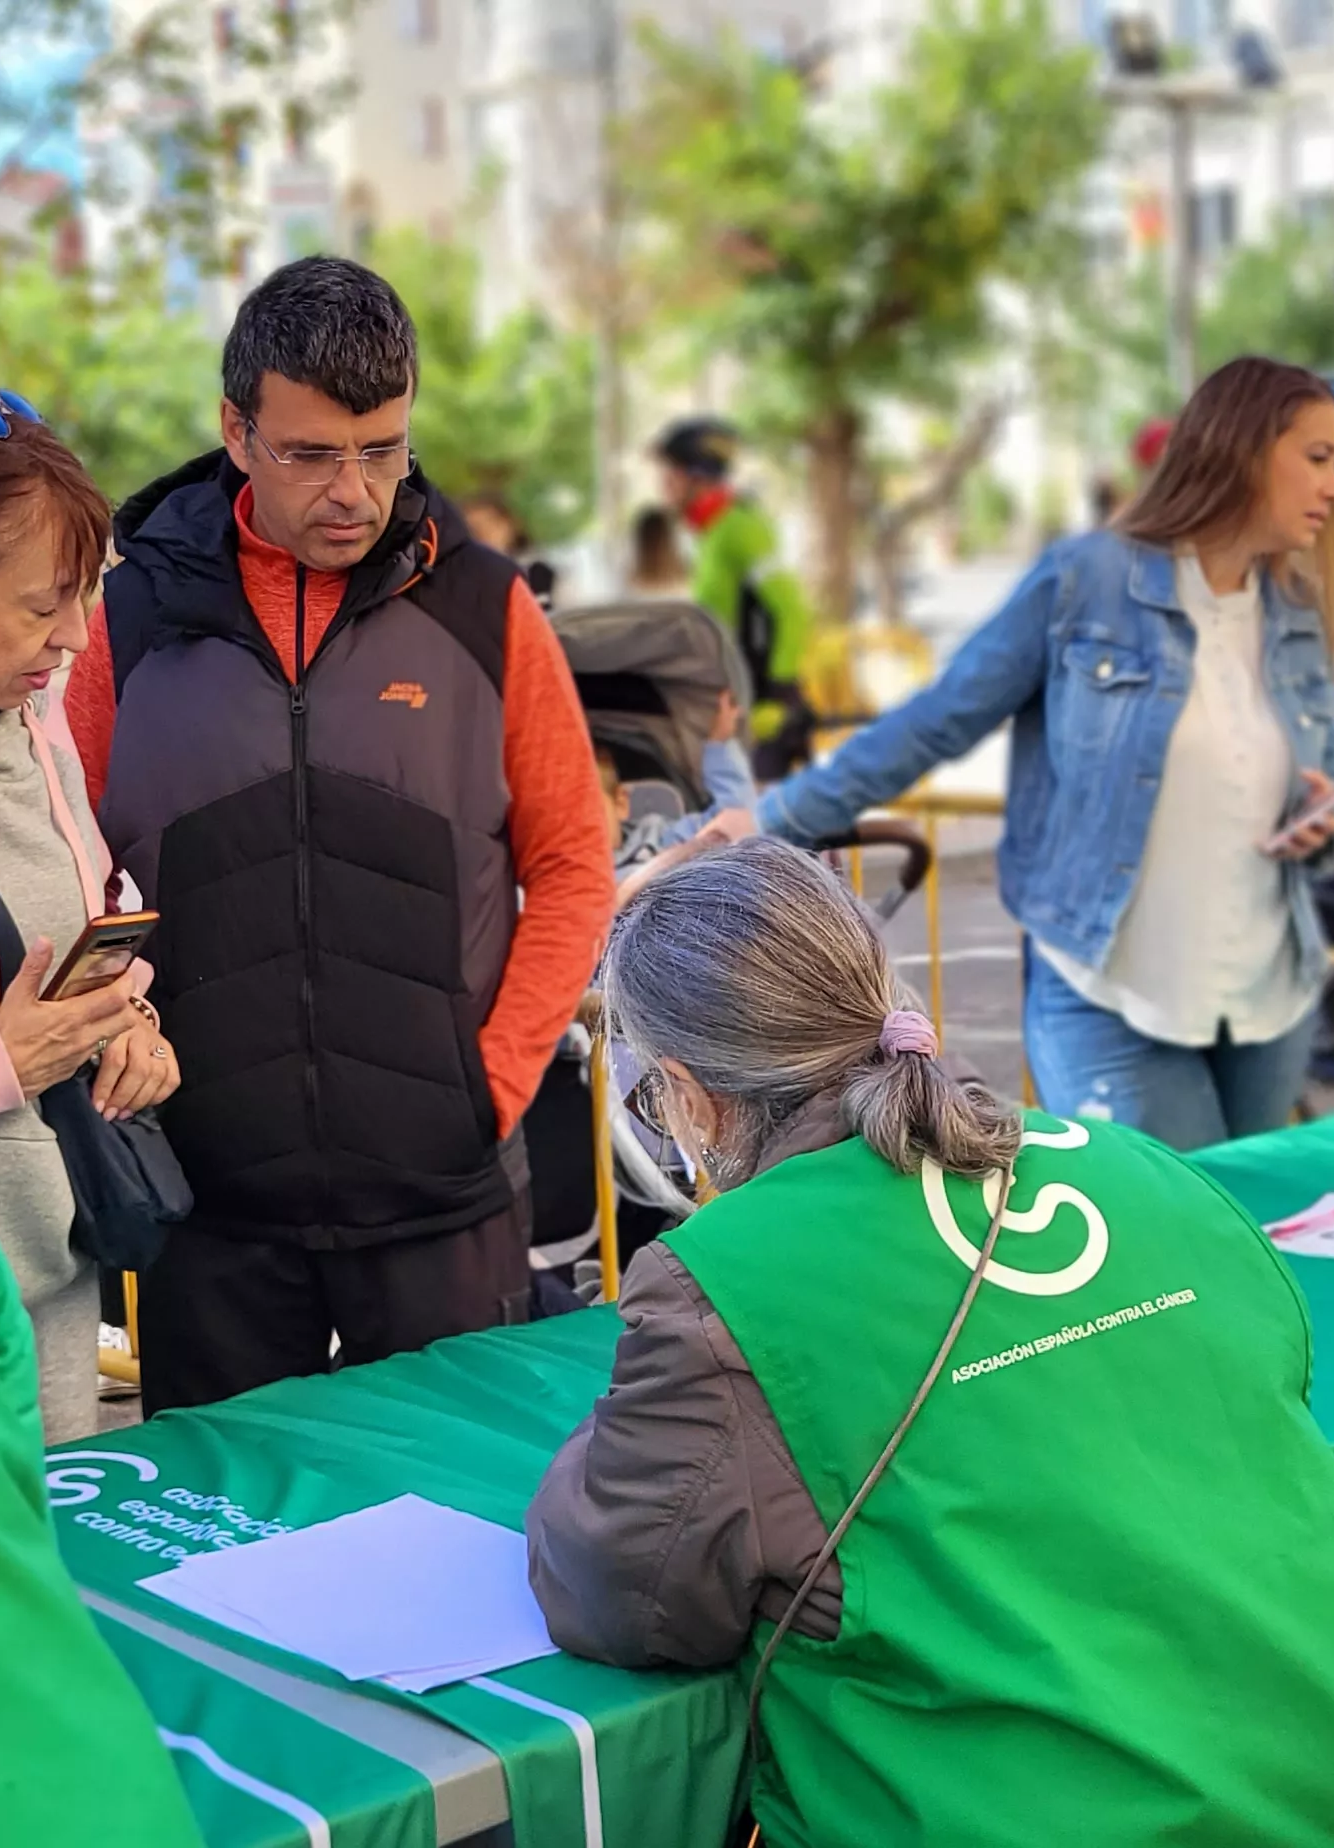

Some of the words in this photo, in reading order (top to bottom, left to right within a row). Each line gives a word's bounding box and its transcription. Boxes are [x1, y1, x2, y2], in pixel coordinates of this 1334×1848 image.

[951, 1343, 1036, 1384] ASOCIACIÓN
[1035, 1321, 1097, 1354] ESPAÑOLA
[1096, 1306, 1144, 1332] CONTRA
[1142, 1300, 1159, 1316] EL
[1156, 1289, 1197, 1310] CÁNCER
[74, 1511, 168, 1553] contra
[160, 1487, 295, 1538] asociació
